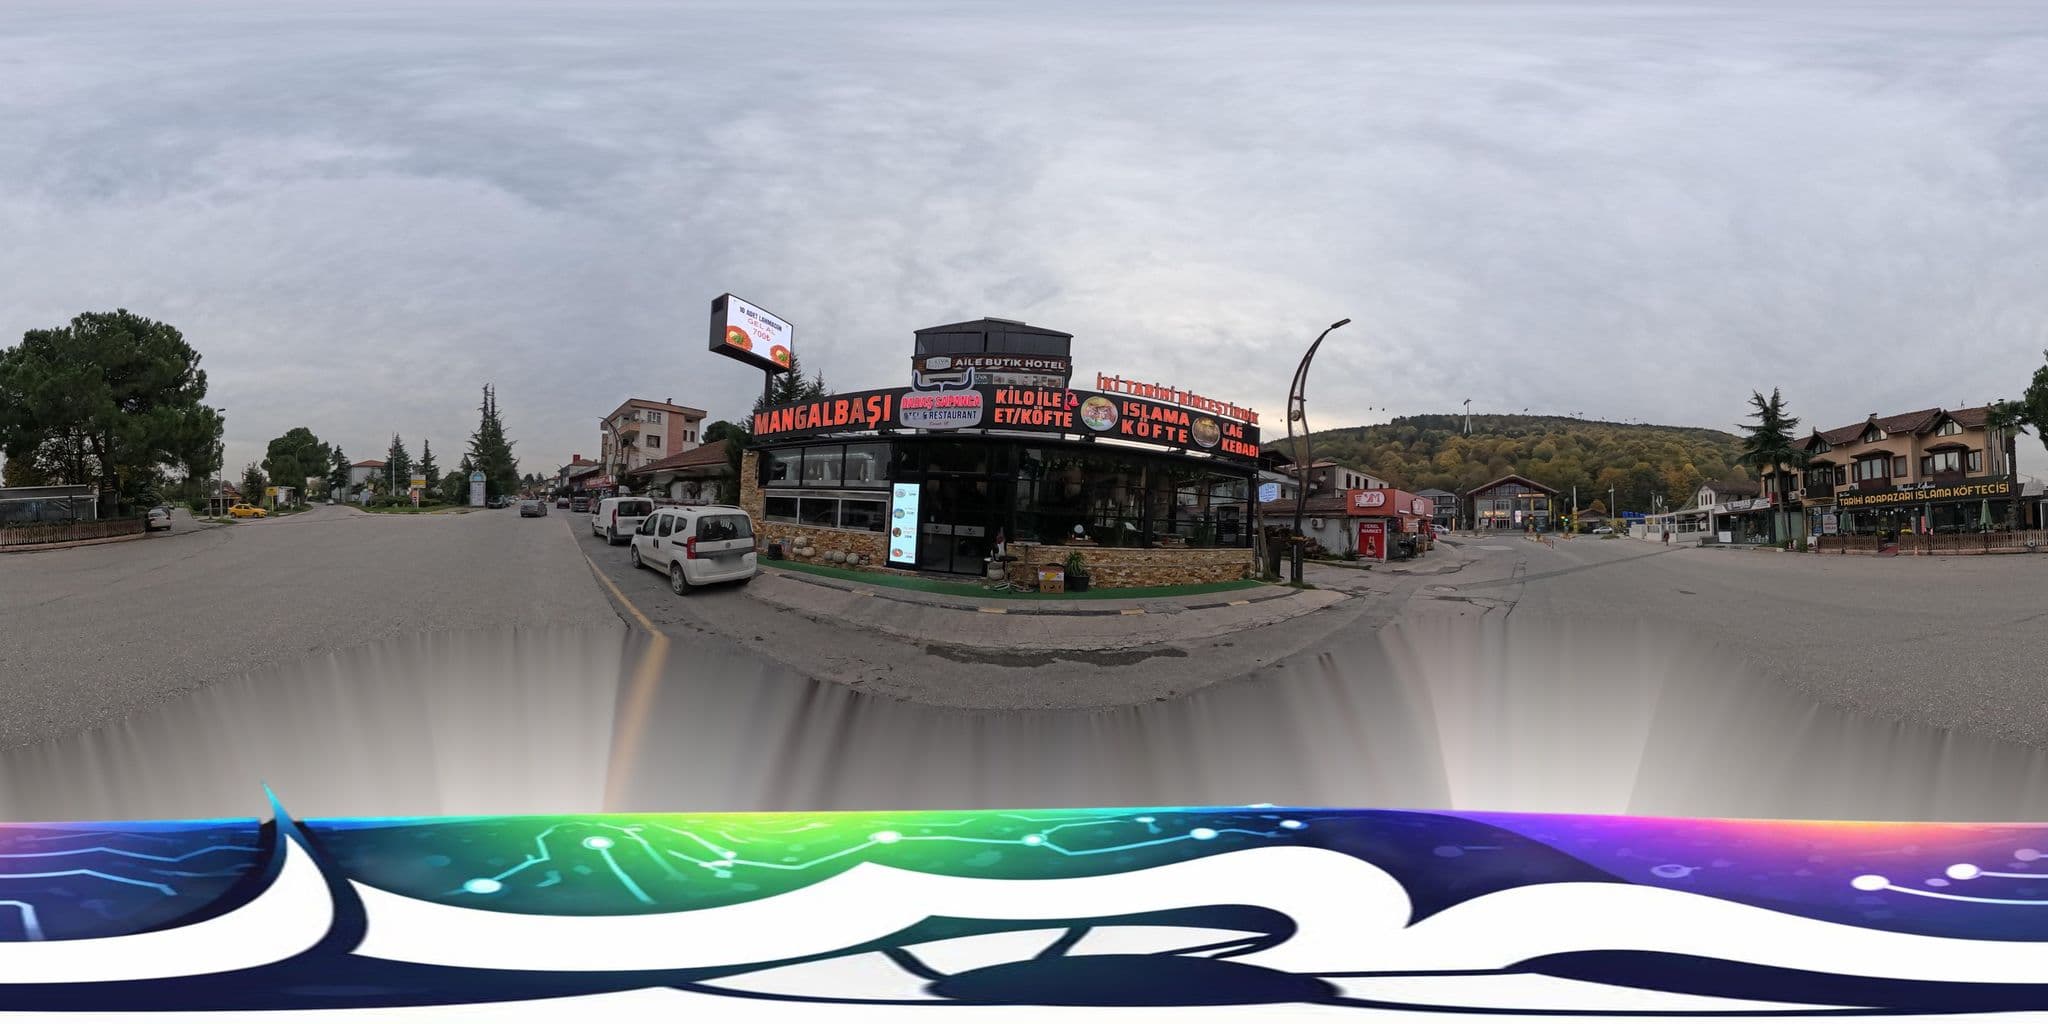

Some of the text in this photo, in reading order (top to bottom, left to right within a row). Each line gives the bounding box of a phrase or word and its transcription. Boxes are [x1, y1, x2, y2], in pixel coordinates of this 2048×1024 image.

[746, 309, 758, 320] ADET
[747, 318, 764, 330] GEL
[1025, 359, 1065, 370] HOTEL
[1096, 372, 1120, 392] İKİ
[995, 386, 1062, 408] KİLO İLE
[754, 394, 892, 436] MANGALBAŞI
[928, 410, 977, 420] RESTAURANT
[994, 406, 1073, 428] ET/KÖFTE
[1122, 401, 1190, 427] ISLAMA
[1121, 418, 1188, 444] KÖFTE
[1221, 438, 1259, 458] KEBABI
[1839, 494, 1863, 507] TARİHİ
[1864, 491, 1914, 505] ADAPAZARI
[1915, 488, 1951, 500] ISLAMA
[1953, 481, 2009, 497] KÖFTECİSİ
